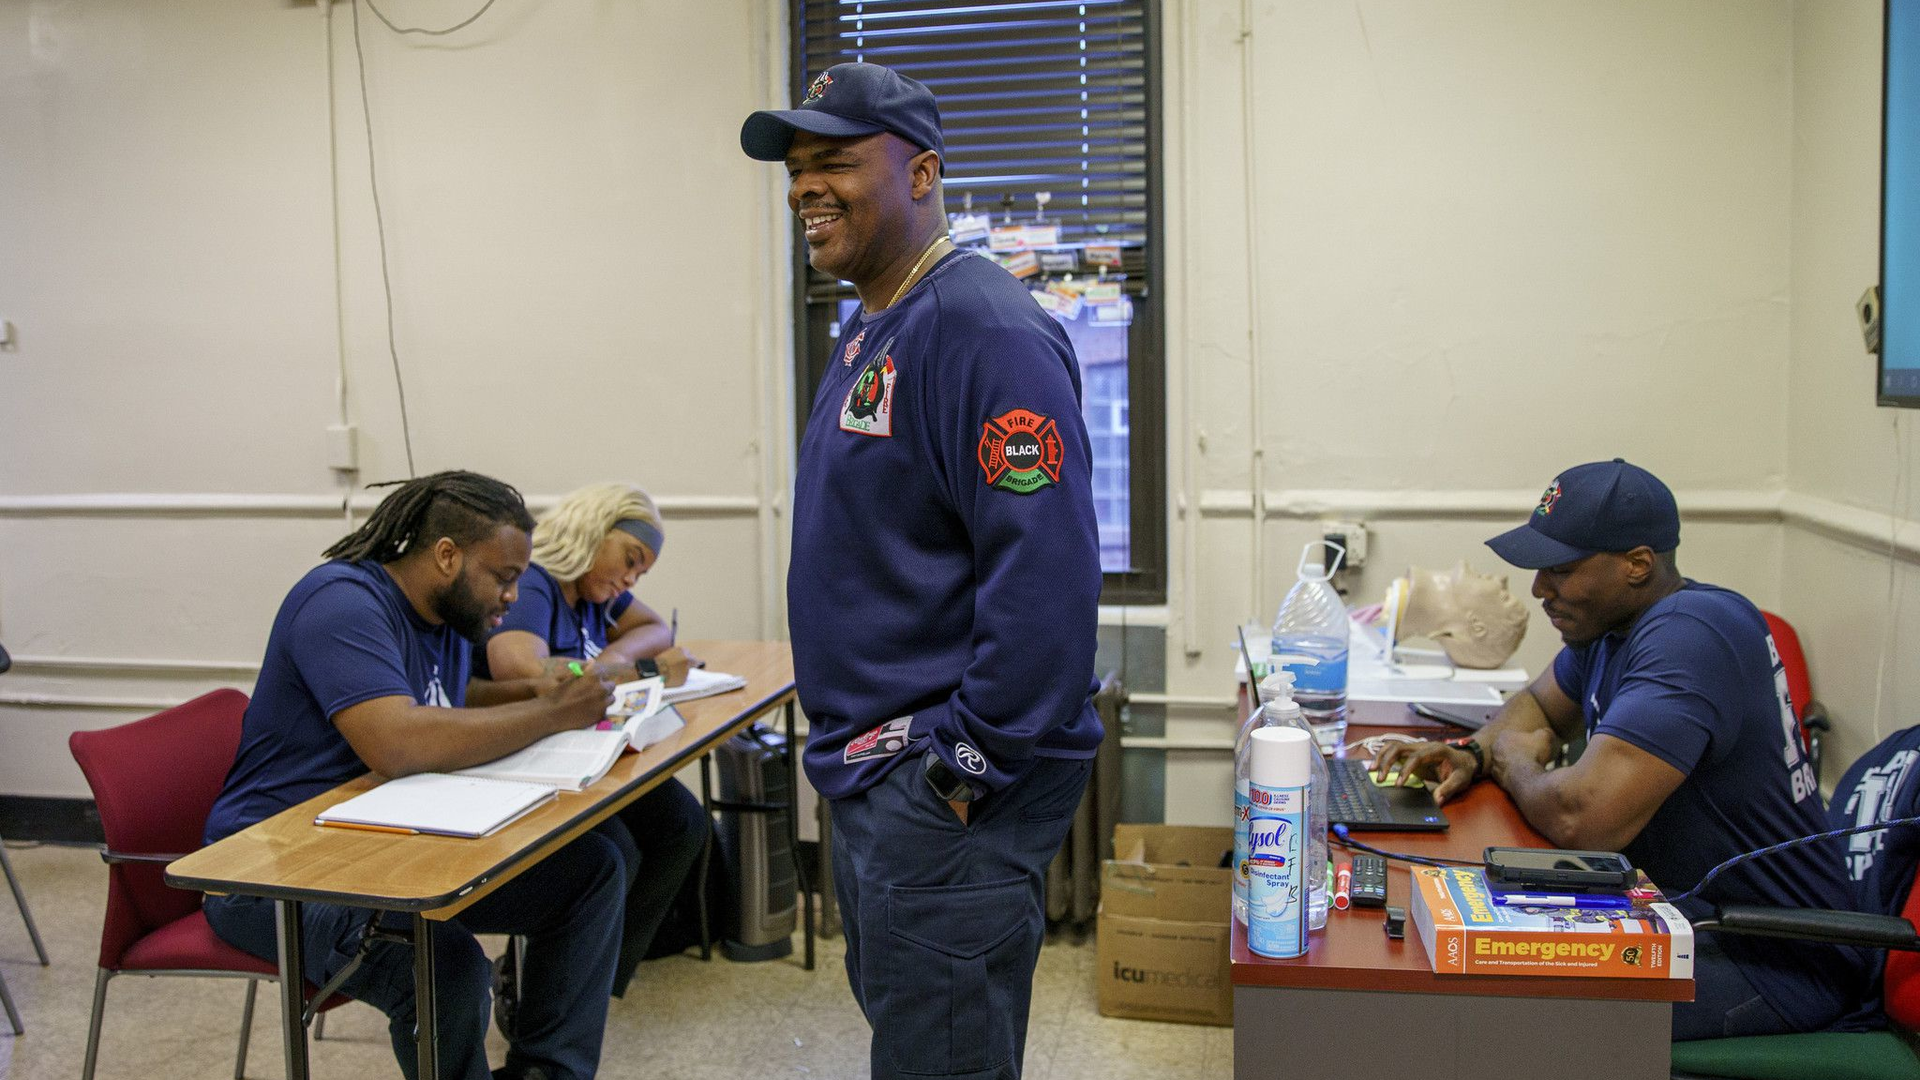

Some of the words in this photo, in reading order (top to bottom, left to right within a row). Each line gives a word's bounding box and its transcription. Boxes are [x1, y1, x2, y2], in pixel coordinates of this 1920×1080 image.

[1007, 416, 1035, 428] FIRE
[1005, 444, 1040, 457] BLACK
[1005, 473, 1044, 487] BRIGADE
[1250, 867, 1290, 880] Disinfectant
[1266, 880, 1289, 888] Spray
[1447, 937, 1458, 966] AAOS
[1475, 937, 1615, 961] Emergency
[1625, 950, 1636, 962] 50
